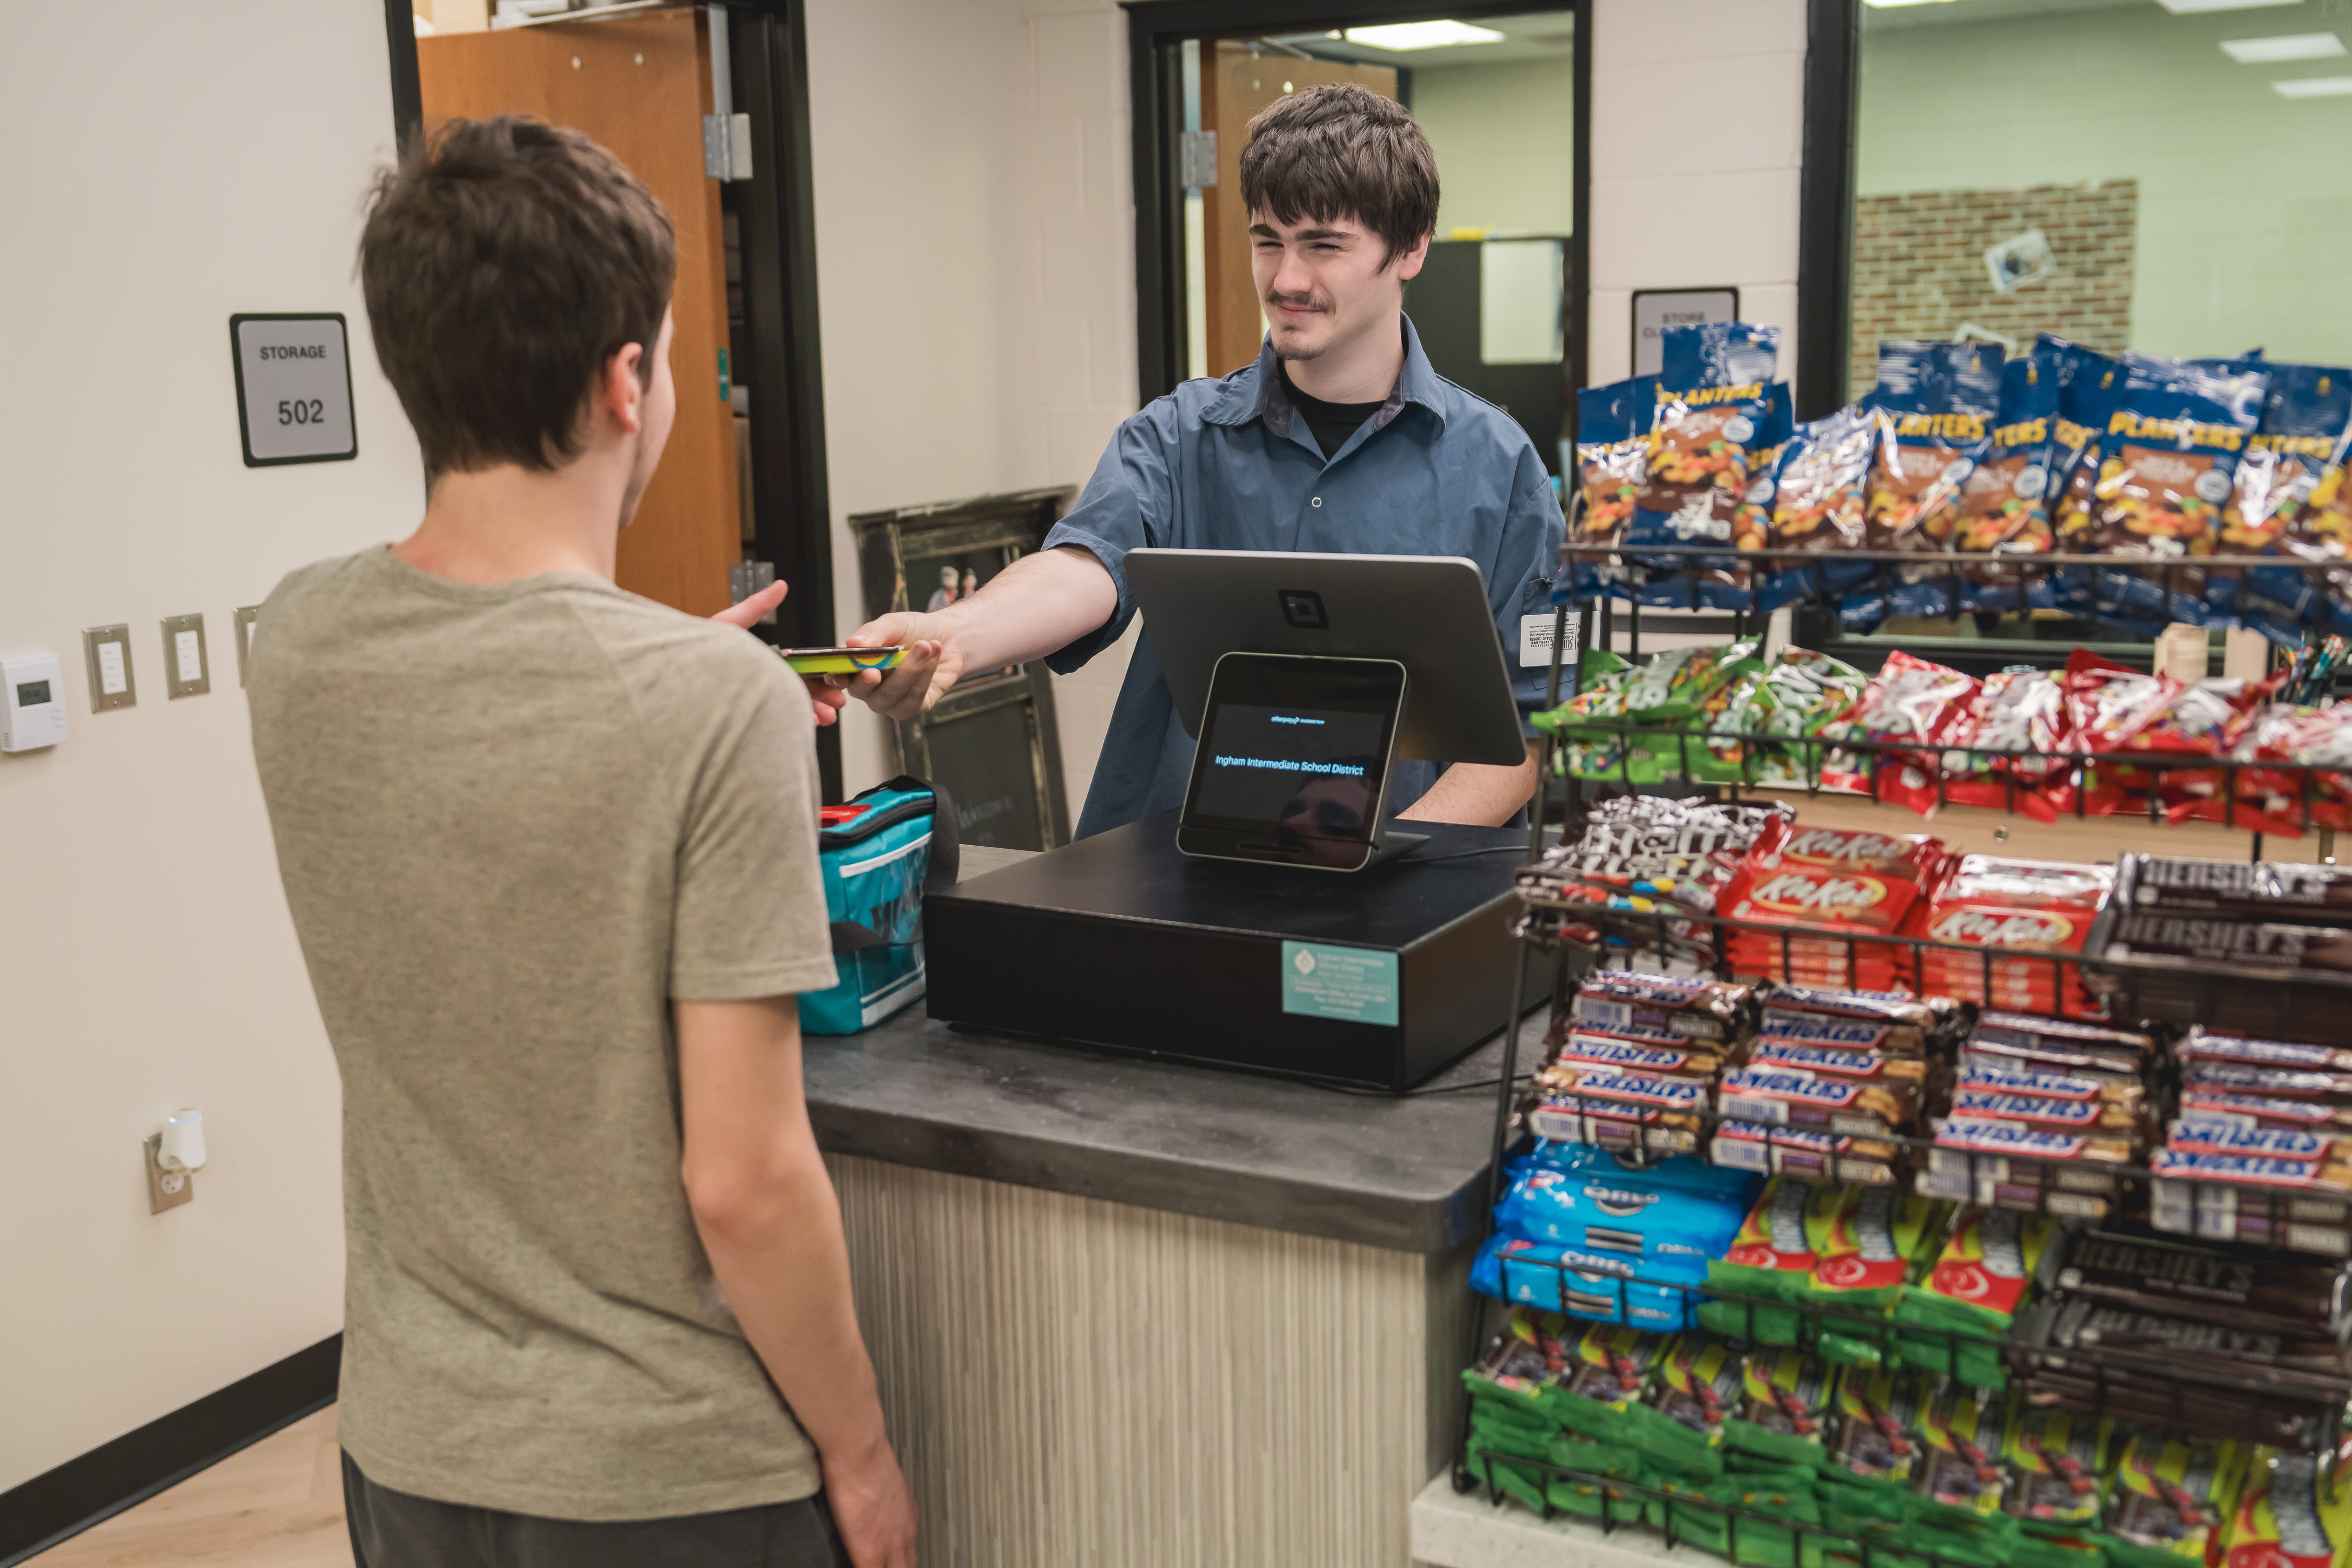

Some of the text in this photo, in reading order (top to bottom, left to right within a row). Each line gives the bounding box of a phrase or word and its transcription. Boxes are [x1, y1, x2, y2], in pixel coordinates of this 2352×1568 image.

[260, 344, 326, 360] STORAGE
[279, 399, 324, 425] 502
[1215, 755, 1364, 776] Ingham Intermediate School District
